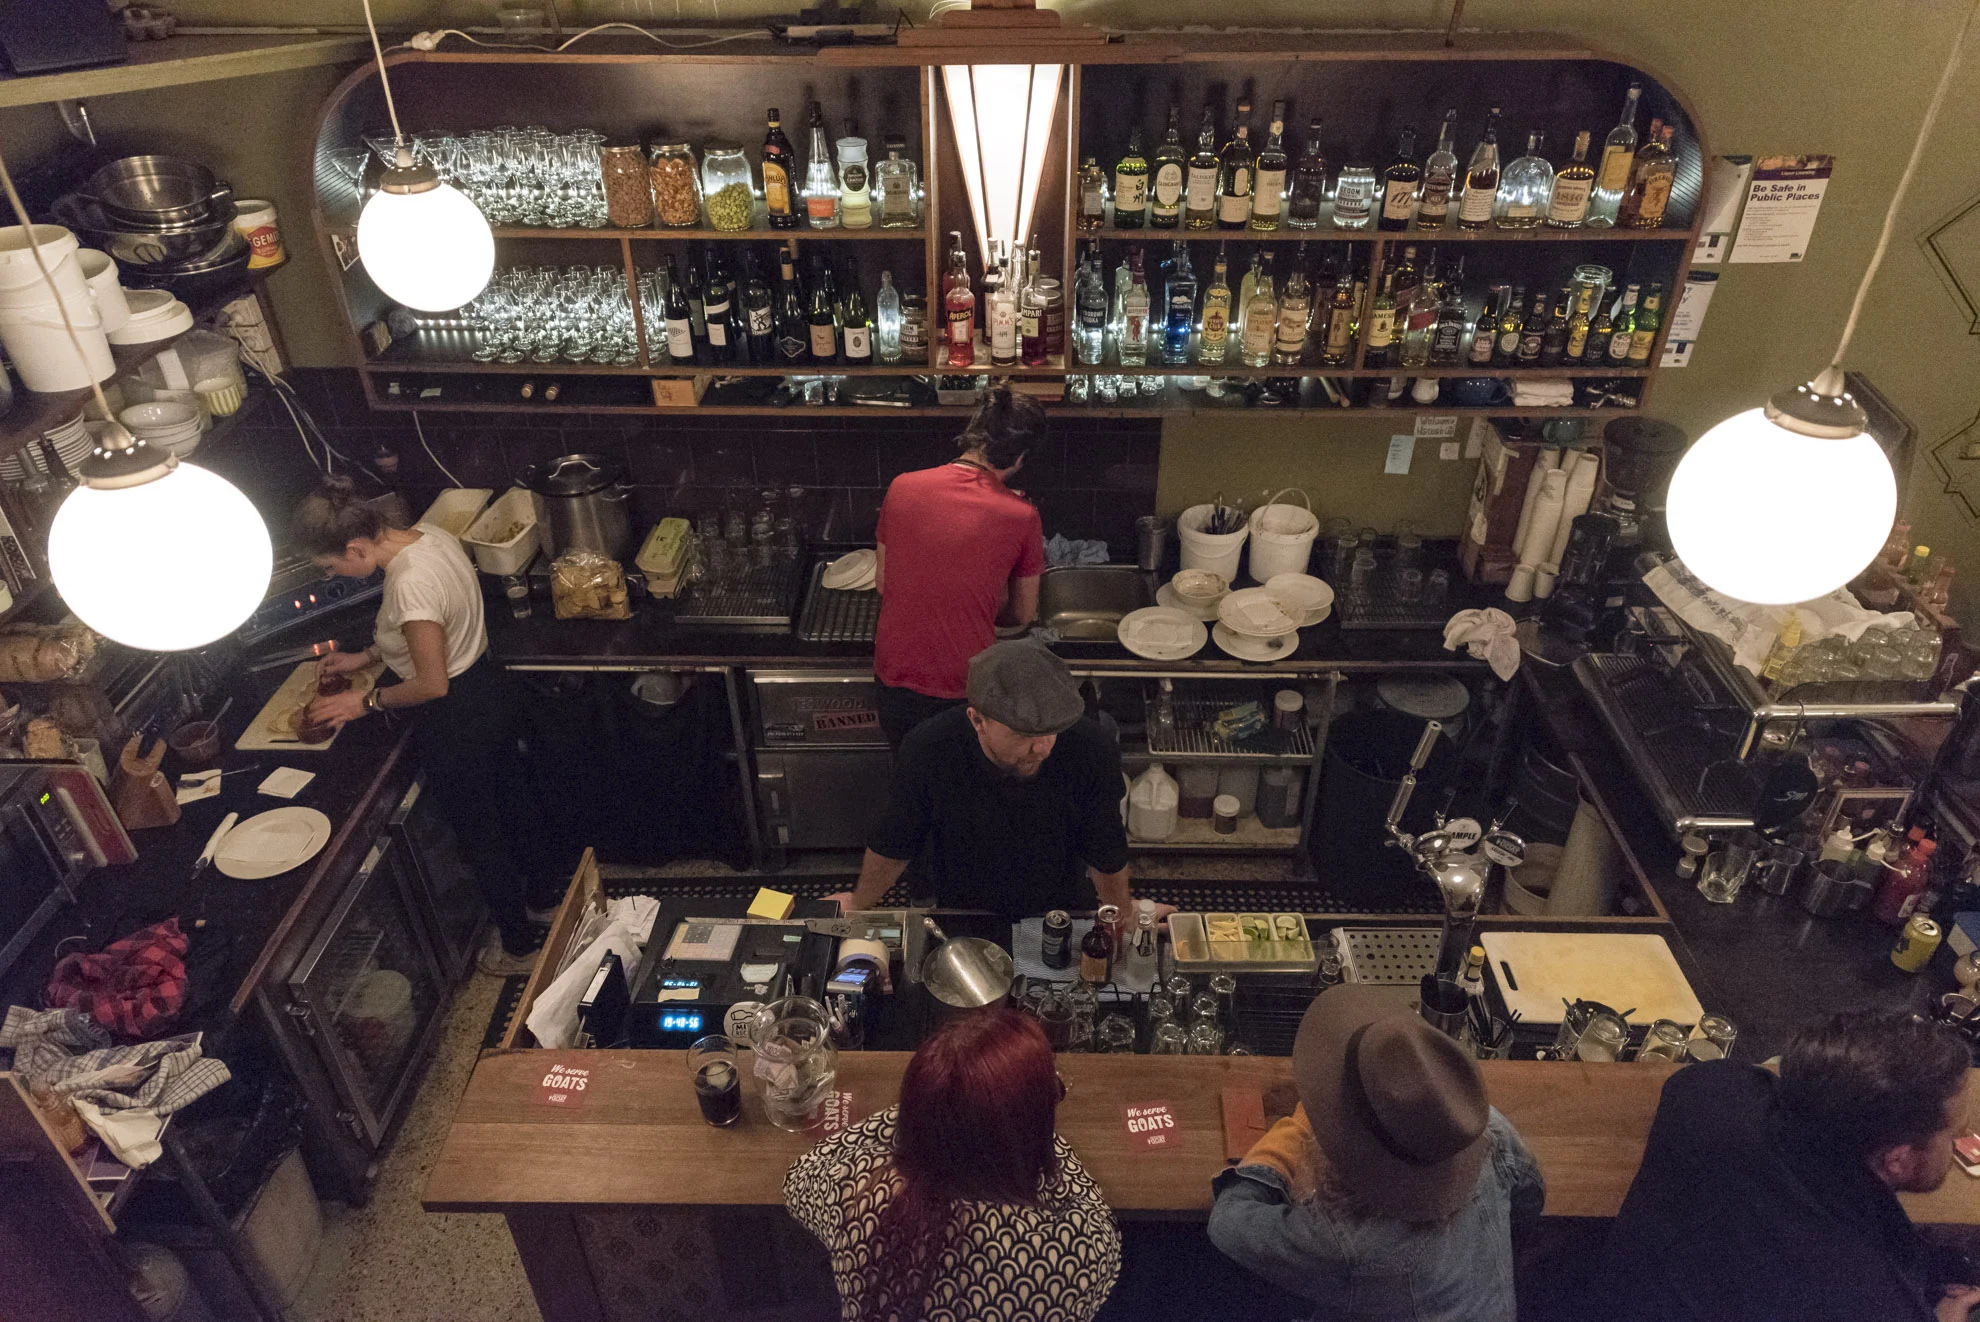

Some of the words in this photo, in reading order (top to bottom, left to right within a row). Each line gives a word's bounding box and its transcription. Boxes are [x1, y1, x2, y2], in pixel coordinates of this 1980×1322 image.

[1753, 185, 1767, 193] Be
[1770, 184, 1794, 193] Safe
[1796, 184, 1806, 192] in
[1750, 193, 1783, 202] Public
[1786, 192, 1820, 201] Places
[948, 309, 971, 320] APEROL
[816, 712, 876, 730] BANNED
[1451, 831, 1477, 840] AMPLE
[550, 1063, 566, 1075] We
[566, 1066, 590, 1078] serve
[542, 1073, 588, 1092] GOATS
[842, 1092, 853, 1104] We
[1127, 1107, 1142, 1118] We
[1142, 1106, 1167, 1117] serve
[1127, 1114, 1175, 1133] GOATS
